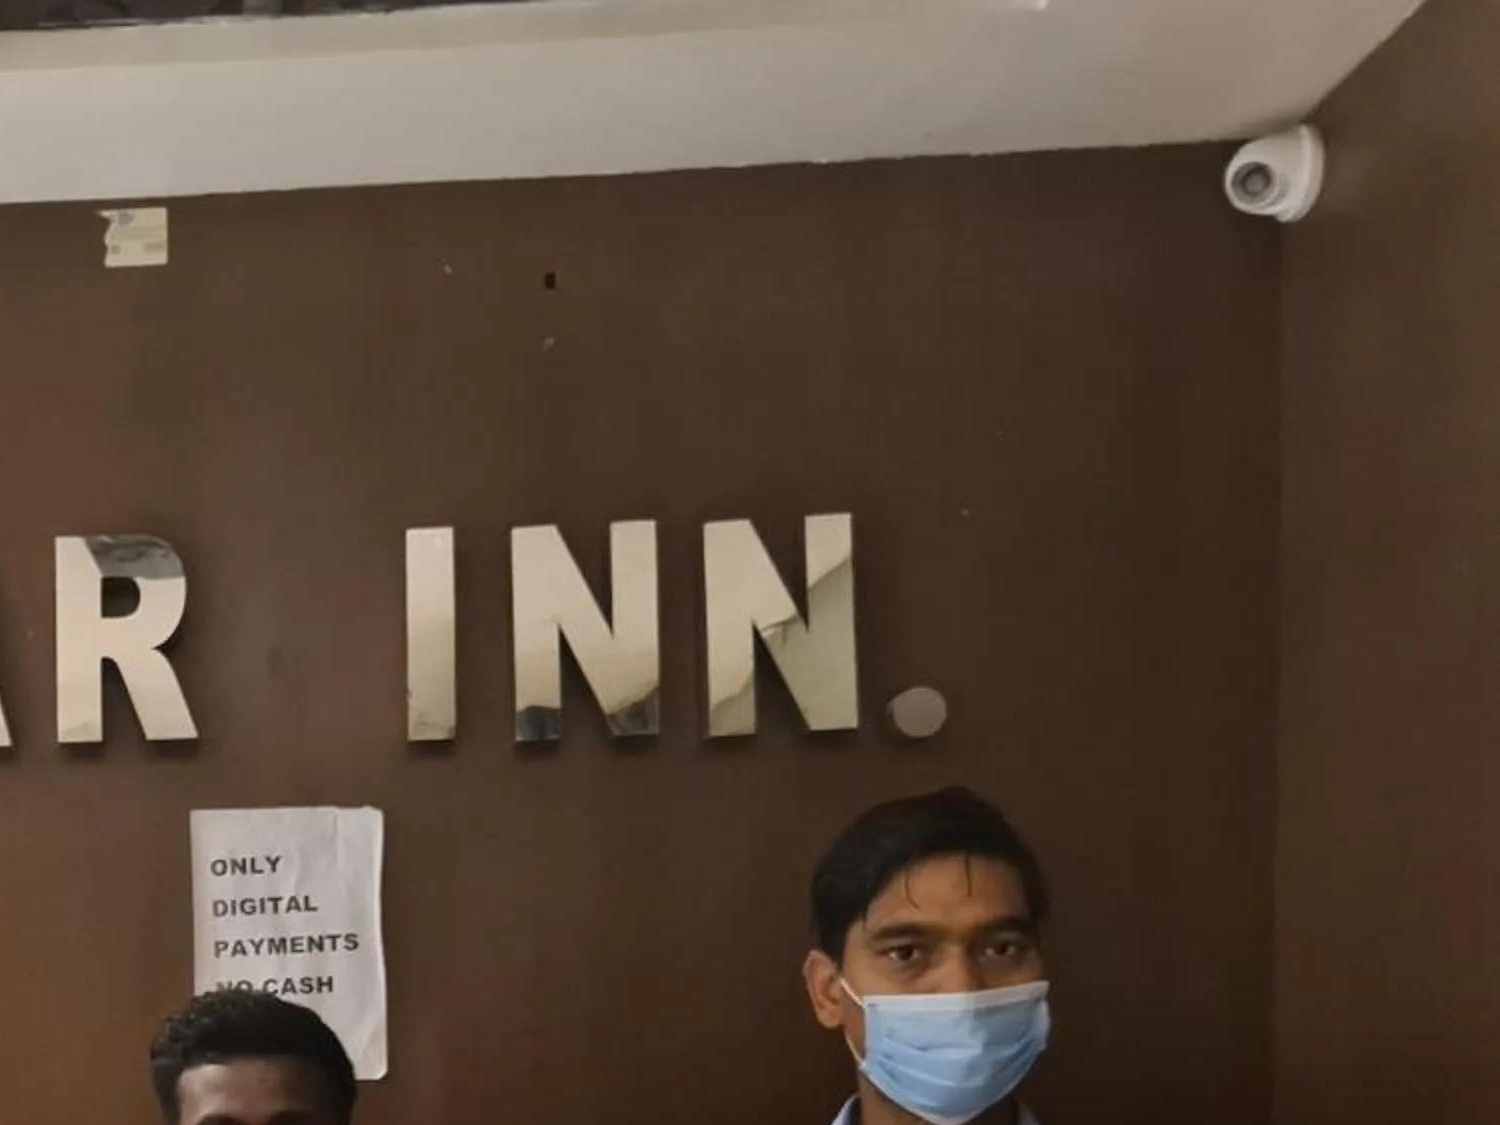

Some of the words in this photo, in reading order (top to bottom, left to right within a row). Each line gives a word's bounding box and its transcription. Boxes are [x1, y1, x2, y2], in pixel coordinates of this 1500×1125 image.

[210, 856, 281, 876] ONLY
[212, 895, 319, 917] DIGITAL
[213, 933, 359, 958] PAYMENTS
[262, 976, 334, 995] CASH
